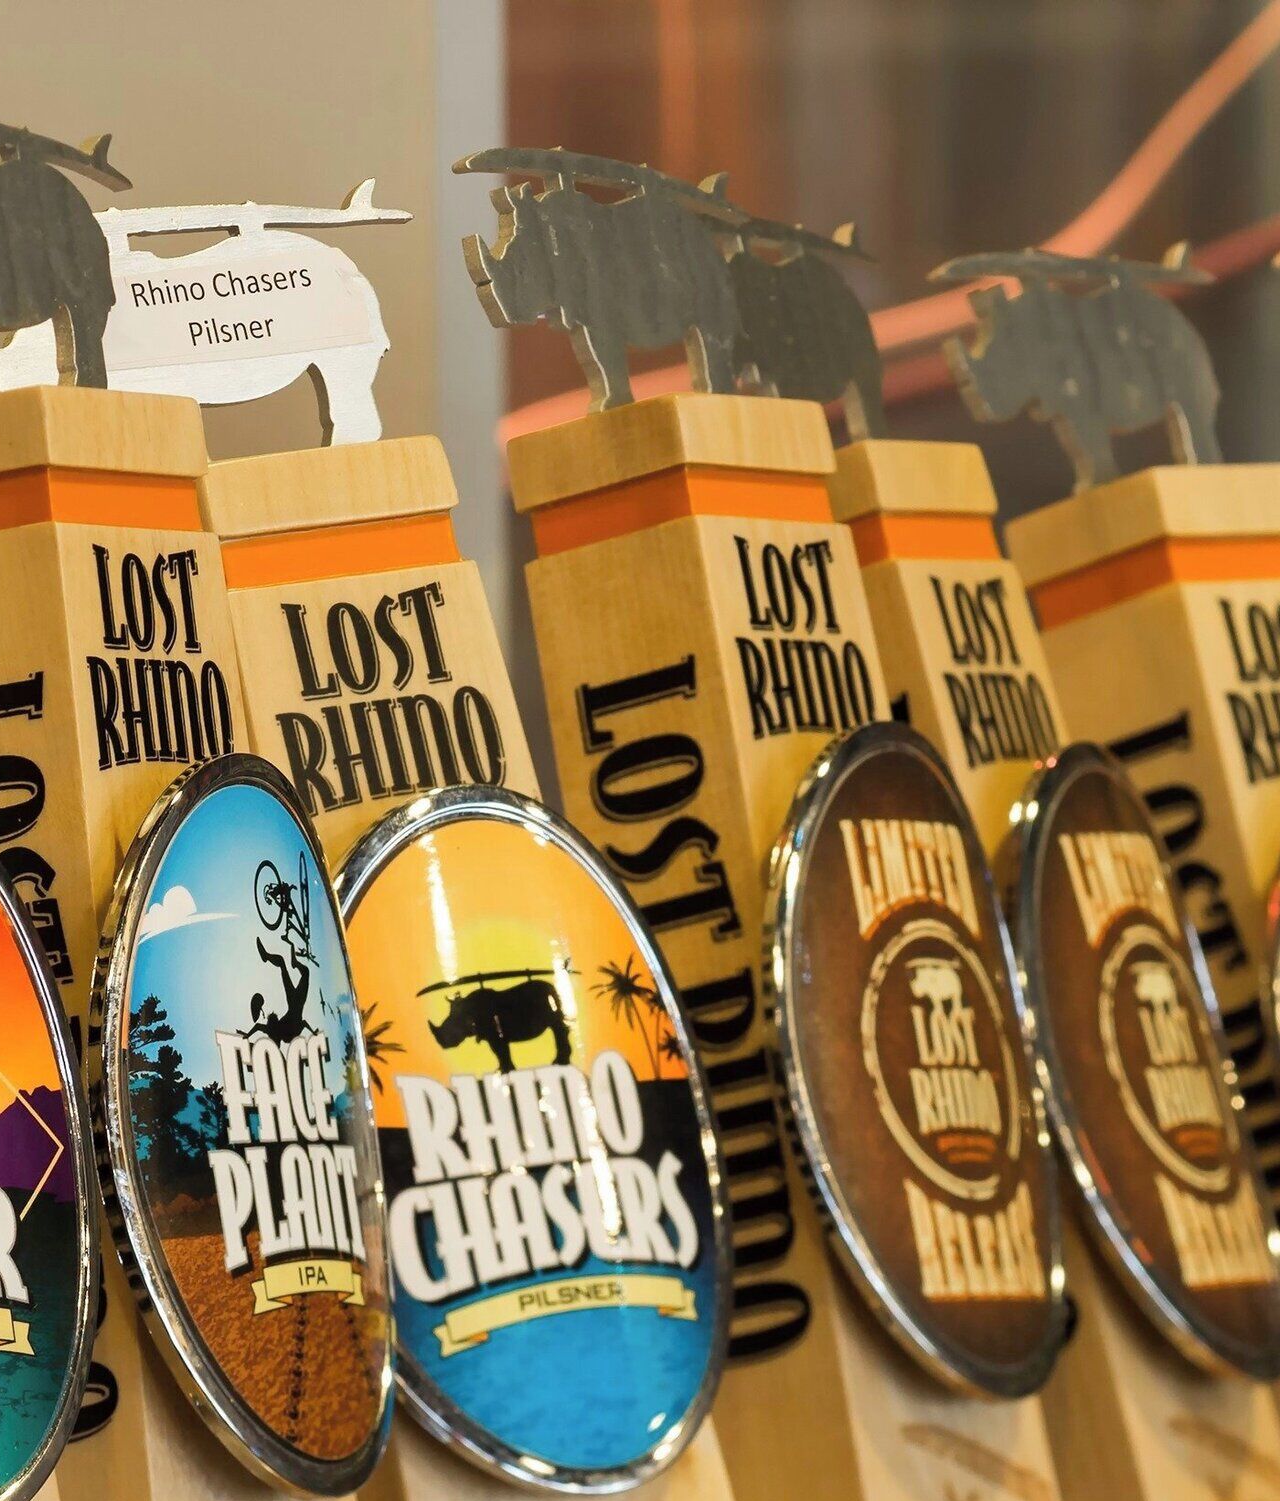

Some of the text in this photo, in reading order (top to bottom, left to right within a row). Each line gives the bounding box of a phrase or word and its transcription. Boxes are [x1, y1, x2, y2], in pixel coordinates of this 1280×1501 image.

[130, 263, 313, 309] Rhino Chasers
[187, 315, 276, 348] Pilsner
[91, 543, 202, 655] LOST
[734, 534, 841, 633] LOST
[929, 575, 1020, 666] LOST
[281, 581, 452, 701] LOST
[735, 636, 876, 741] RHINO
[86, 655, 235, 771] RHINO
[275, 685, 506, 818] RHINO
[942, 671, 1062, 770] RHINO
[574, 652, 742, 943] LOST
[213, 1028, 340, 1146] FACE
[910, 1004, 981, 1067] LOST
[394, 1048, 644, 1184] RHINO
[209, 1143, 368, 1273] PLANT
[389, 1149, 700, 1305] CHASERS
[296, 1264, 330, 1288] IPA
[518, 1280, 626, 1314] PILSNER
